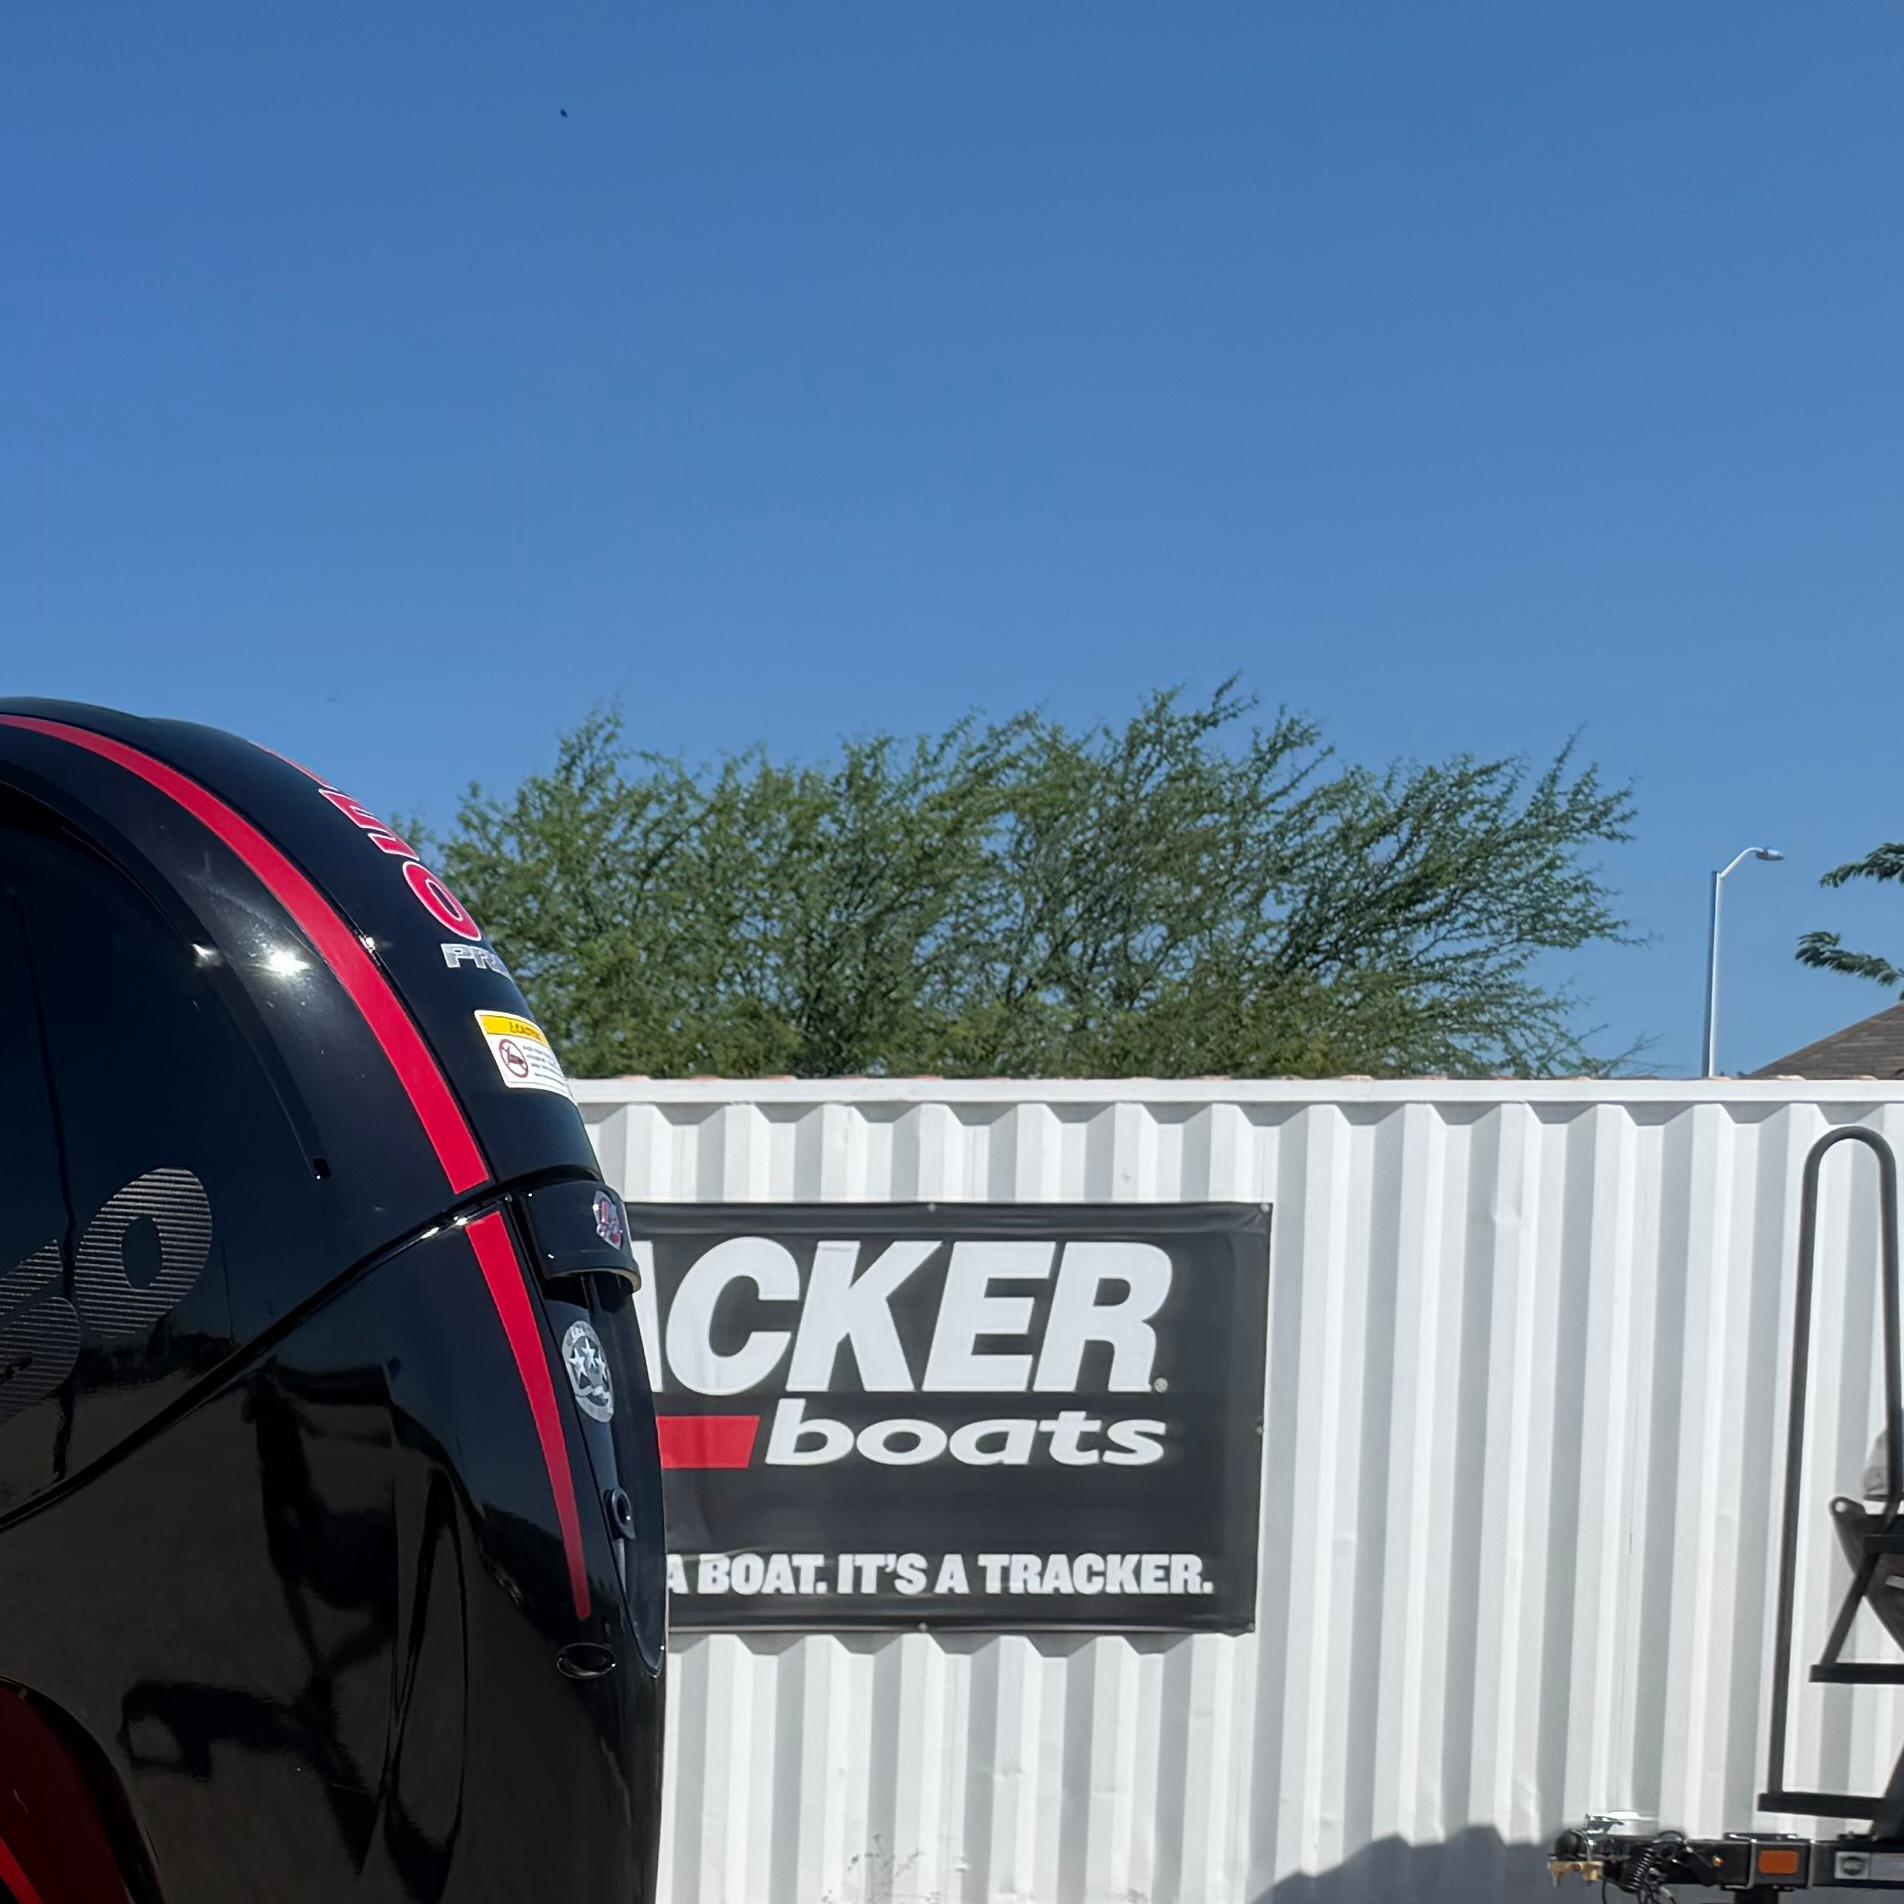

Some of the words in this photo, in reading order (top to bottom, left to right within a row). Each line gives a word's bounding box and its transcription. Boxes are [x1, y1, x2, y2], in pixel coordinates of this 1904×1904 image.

[764, 1397, 1167, 1467] boats
[696, 1552, 828, 1595] BOAT.
[836, 1552, 928, 1596] IT’S
[933, 1553, 970, 1595] A
[976, 1553, 1215, 1595] TRACKER.
